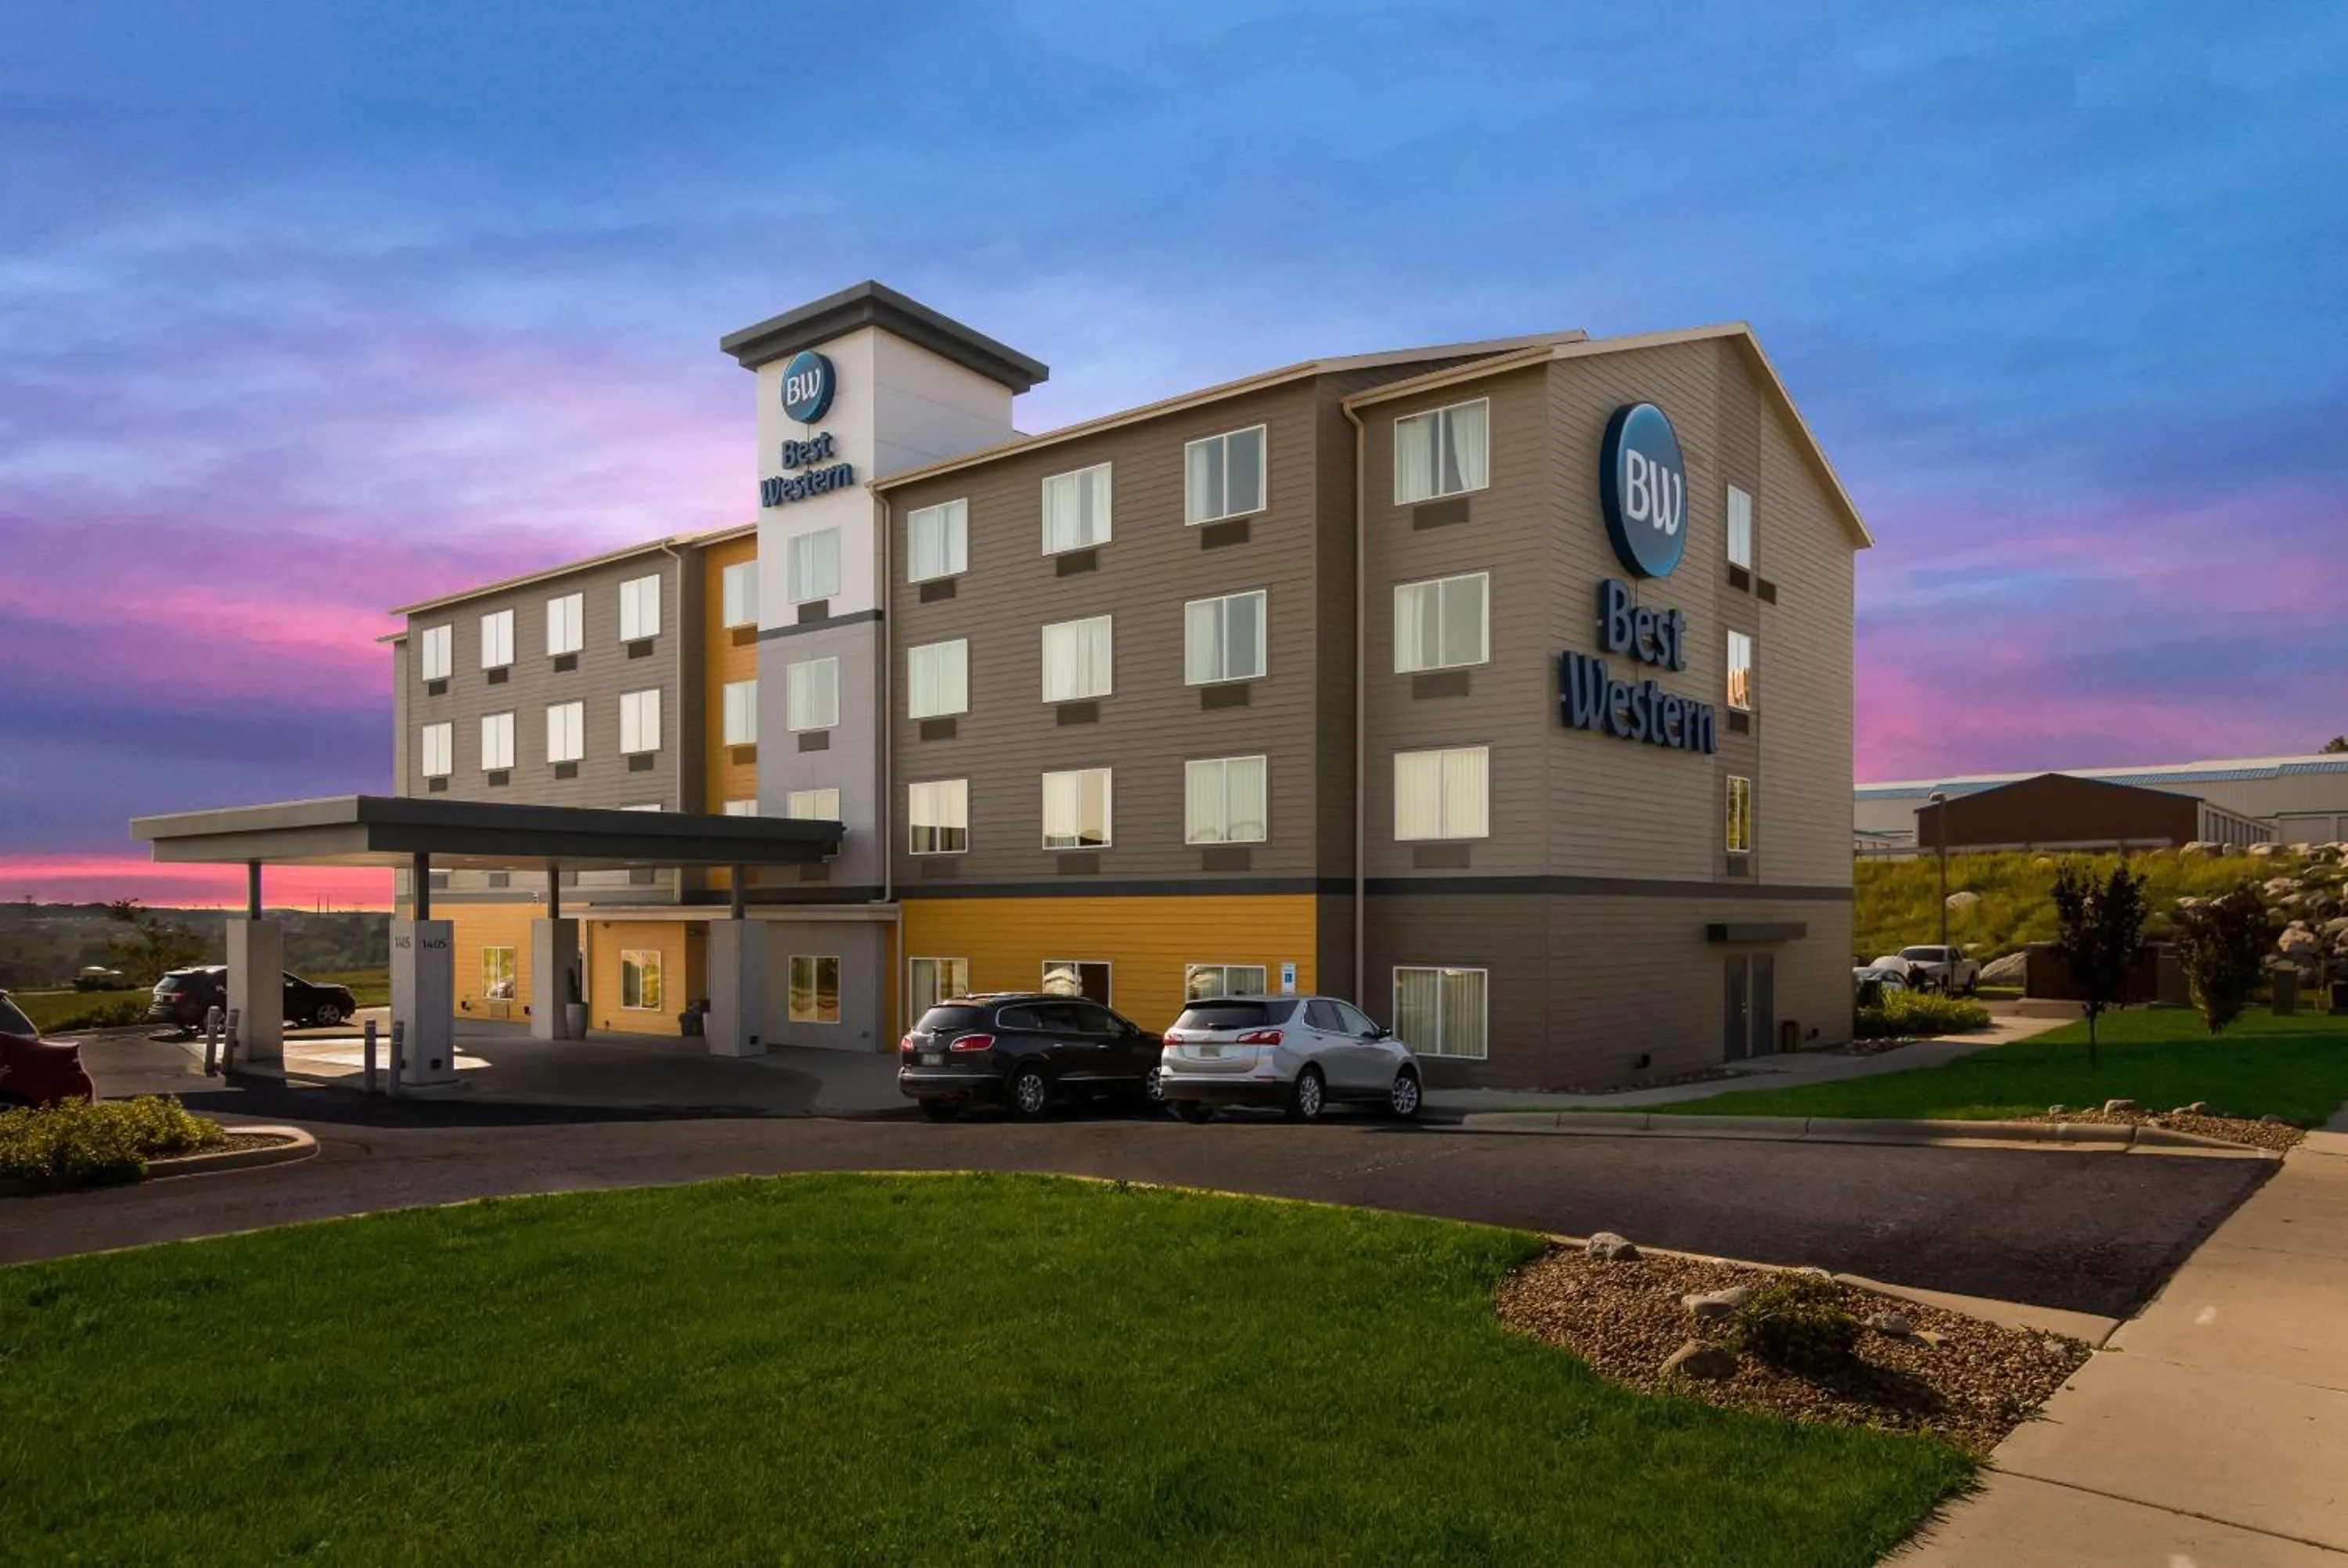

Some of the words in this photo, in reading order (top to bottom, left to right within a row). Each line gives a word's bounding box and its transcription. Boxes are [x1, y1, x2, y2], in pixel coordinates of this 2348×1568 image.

[786, 369, 821, 405] BW
[782, 431, 834, 469] Best
[760, 463, 855, 508] Western
[1626, 448, 1681, 536] BW
[1599, 578, 1686, 671] Best
[1560, 650, 1717, 753] Western
